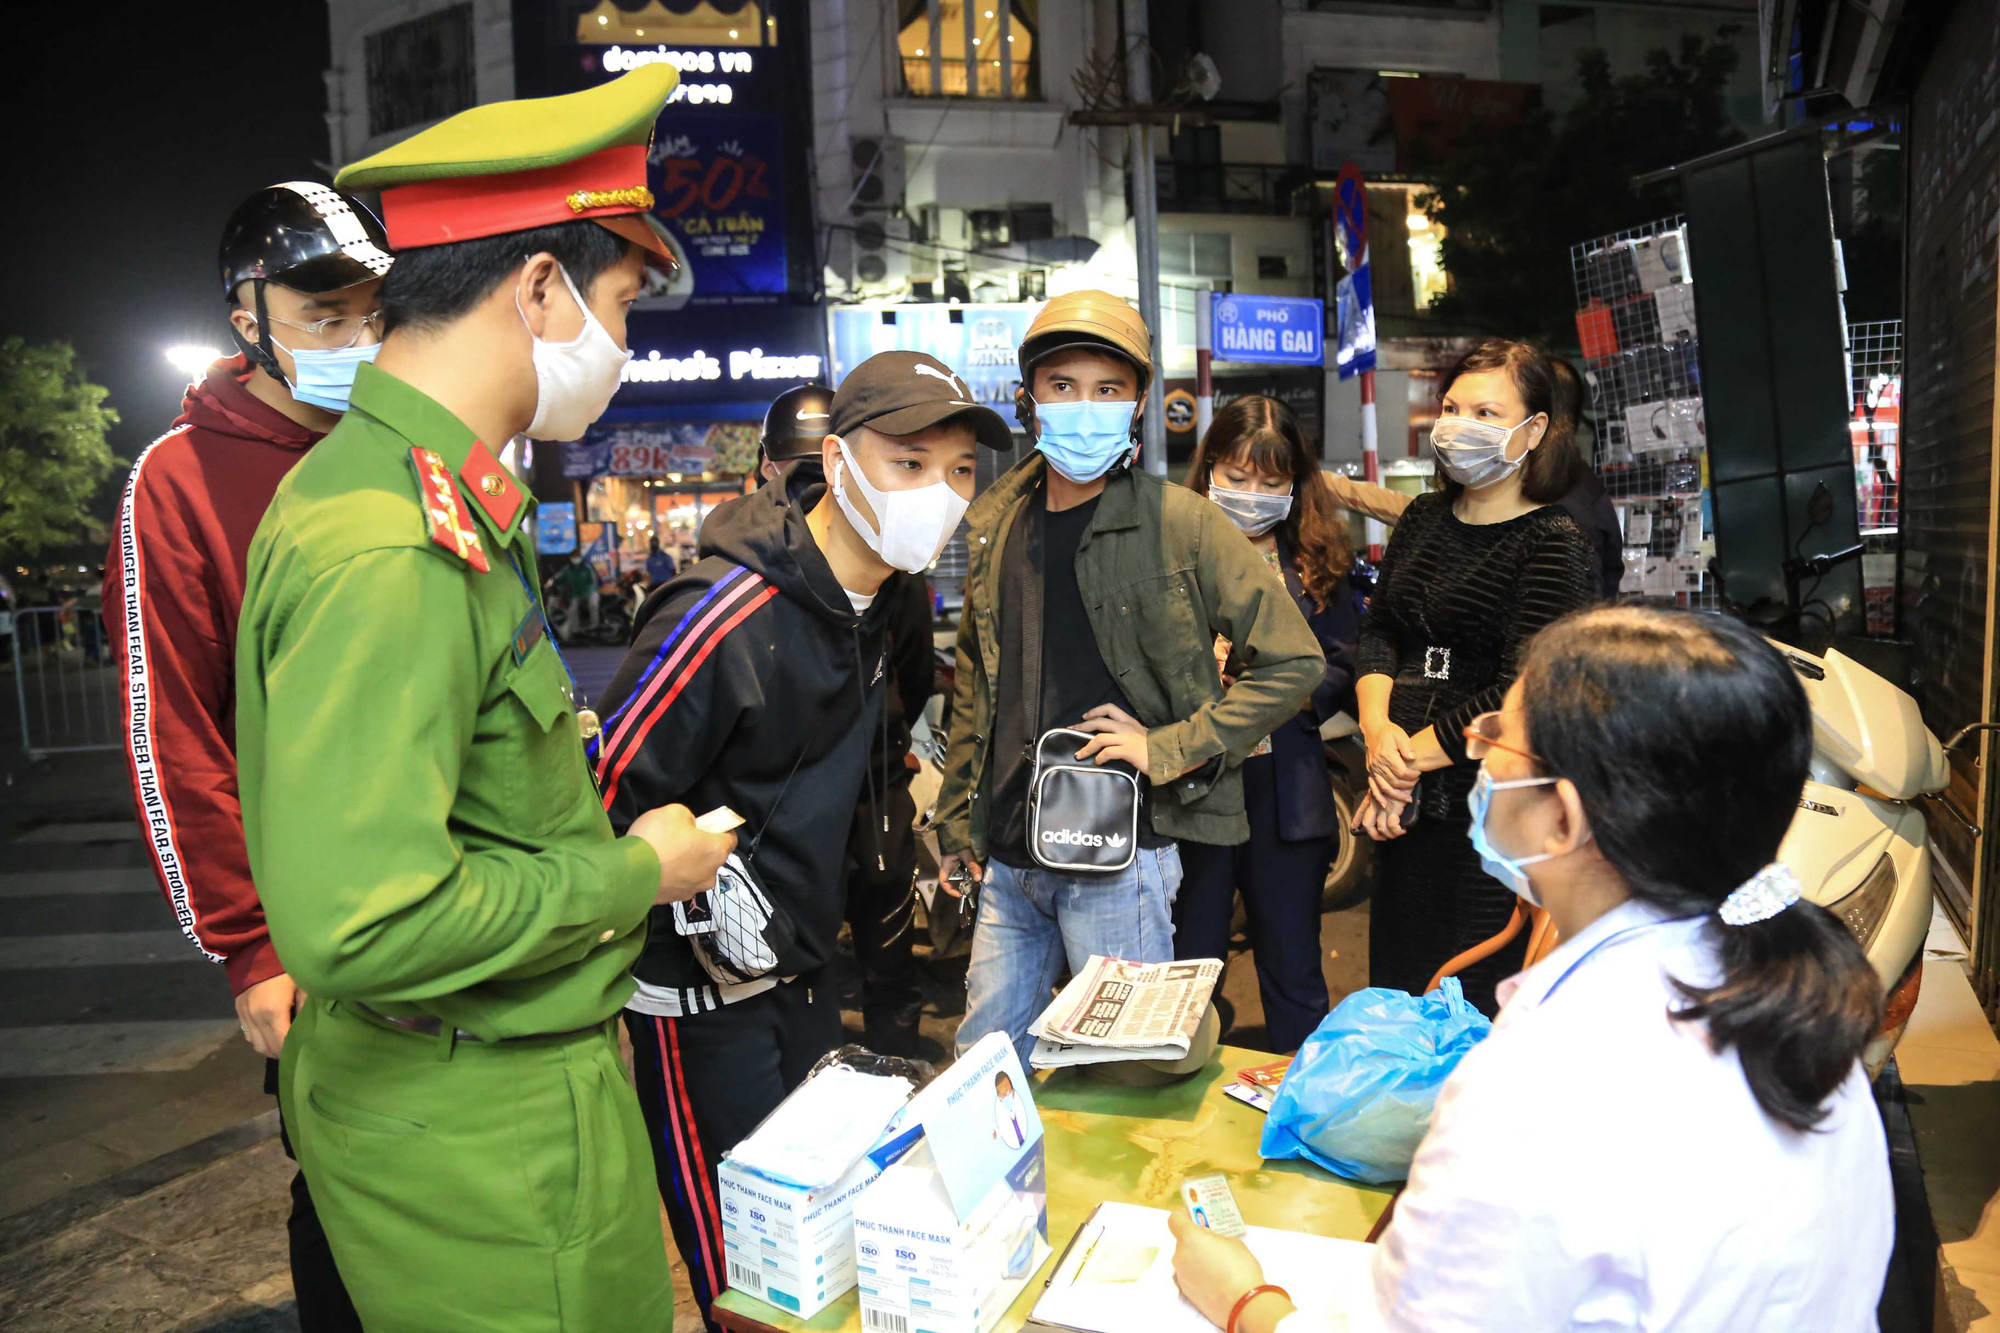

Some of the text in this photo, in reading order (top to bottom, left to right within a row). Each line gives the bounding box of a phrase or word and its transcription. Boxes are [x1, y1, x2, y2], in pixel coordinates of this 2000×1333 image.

[1256, 307, 1289, 323] PHỐ
[1222, 322, 1314, 354] HÀNG GAI
[621, 347, 820, 382] mino's Pizza
[611, 444, 671, 473] 89k
[121, 504, 136, 588] STRONGER
[126, 591, 140, 632] THAN
[129, 635, 144, 680] FEAR.
[131, 683, 150, 764] STRONGER
[139, 767, 160, 807] THAN
[149, 809, 170, 852] FEAR.
[1041, 829, 1103, 847] adidas
[161, 853, 193, 928] STRONGER
[962, 1070, 982, 1093] THANH
[980, 1059, 995, 1076] FACE
[993, 1046, 1009, 1066] MASK
[720, 1177, 793, 1212] PHUC THANH FACE MASK
[724, 1202, 738, 1214] ISO
[749, 1208, 766, 1223] ISO
[802, 1208, 822, 1224] PHUC
[824, 1193, 847, 1212] THANH
[847, 1185, 864, 1198] FACE
[855, 1218, 952, 1245] PHUC THANH FACE MASK
[861, 1246, 916, 1261] ISO ISO
